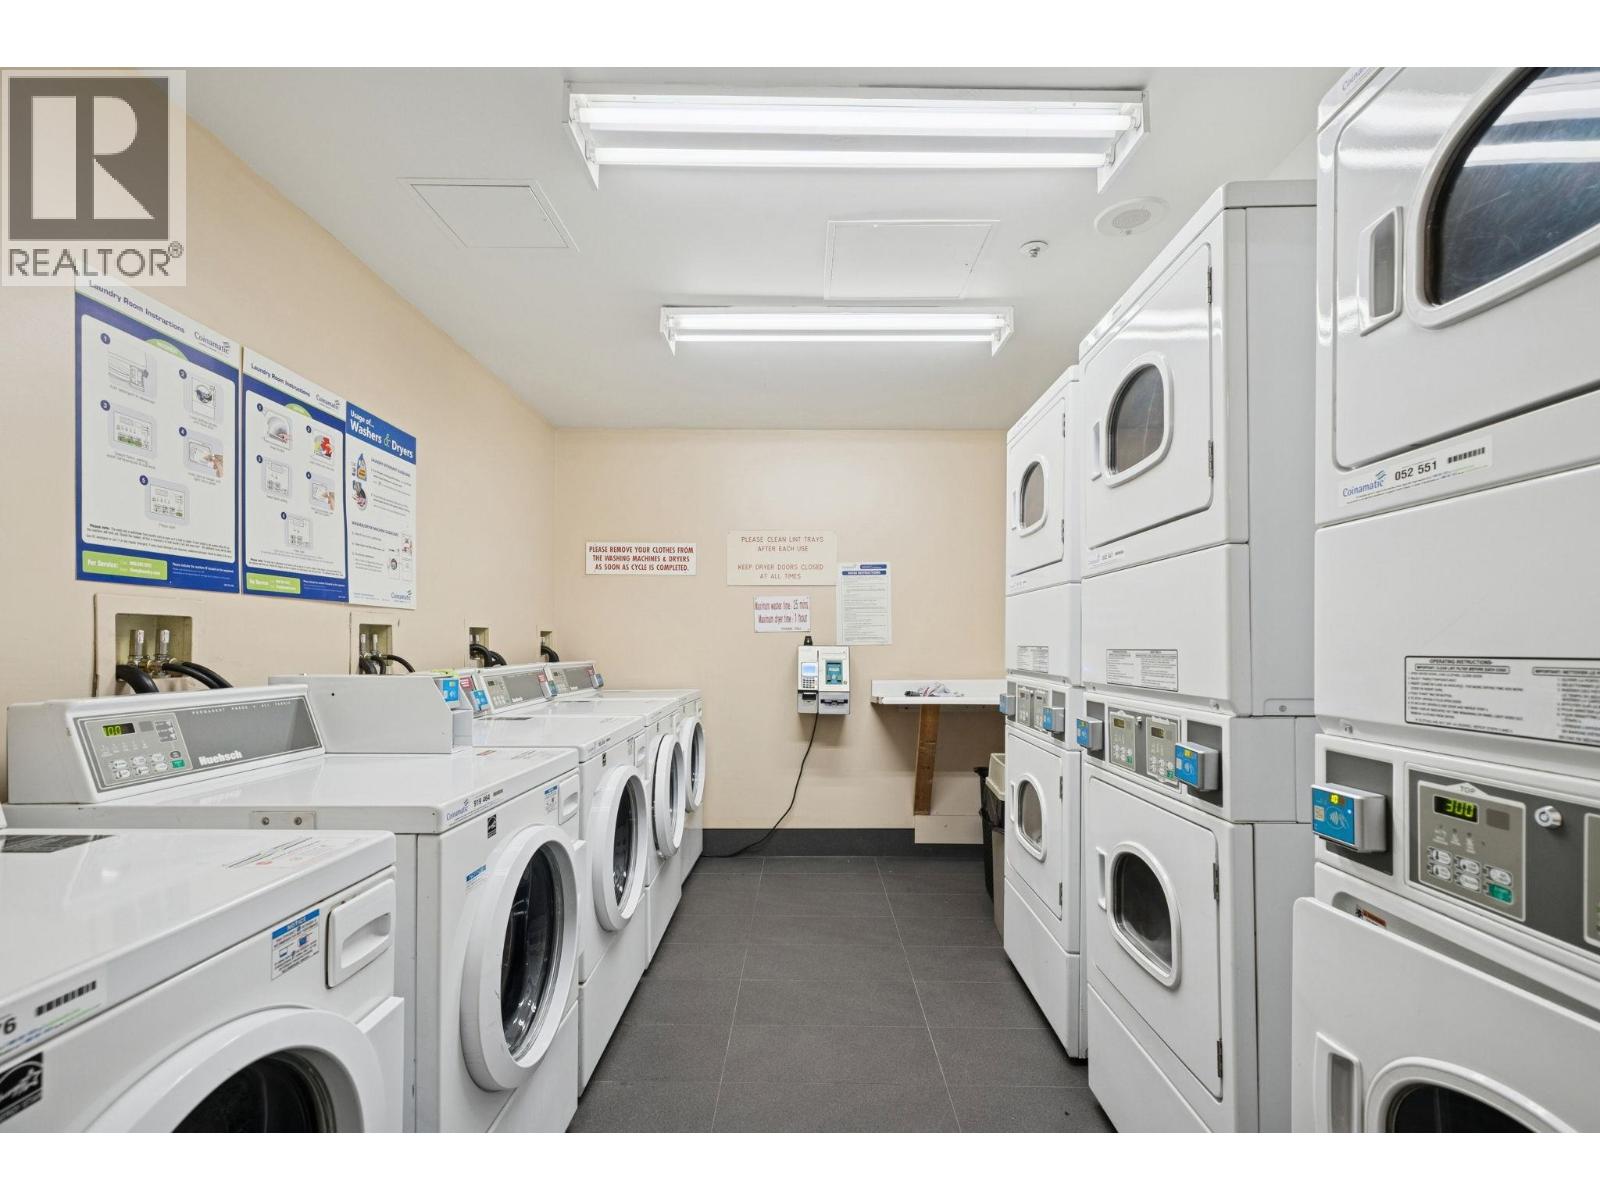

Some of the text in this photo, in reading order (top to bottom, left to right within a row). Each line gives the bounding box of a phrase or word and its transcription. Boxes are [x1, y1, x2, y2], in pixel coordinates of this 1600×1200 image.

[89, 280, 185, 334] Laundry Room Instructions
[194, 331, 230, 354] Coinamatic
[251, 362, 310, 397] Laundry Room Instructions
[350, 409, 365, 422] Usage
[350, 419, 413, 458] Washers & Dryers
[1395, 461, 1437, 481] 052 551
[1342, 479, 1384, 497] Coinamatic
[199, 750, 243, 766] Huebsch
[0, 1016, 16, 1034] 6
